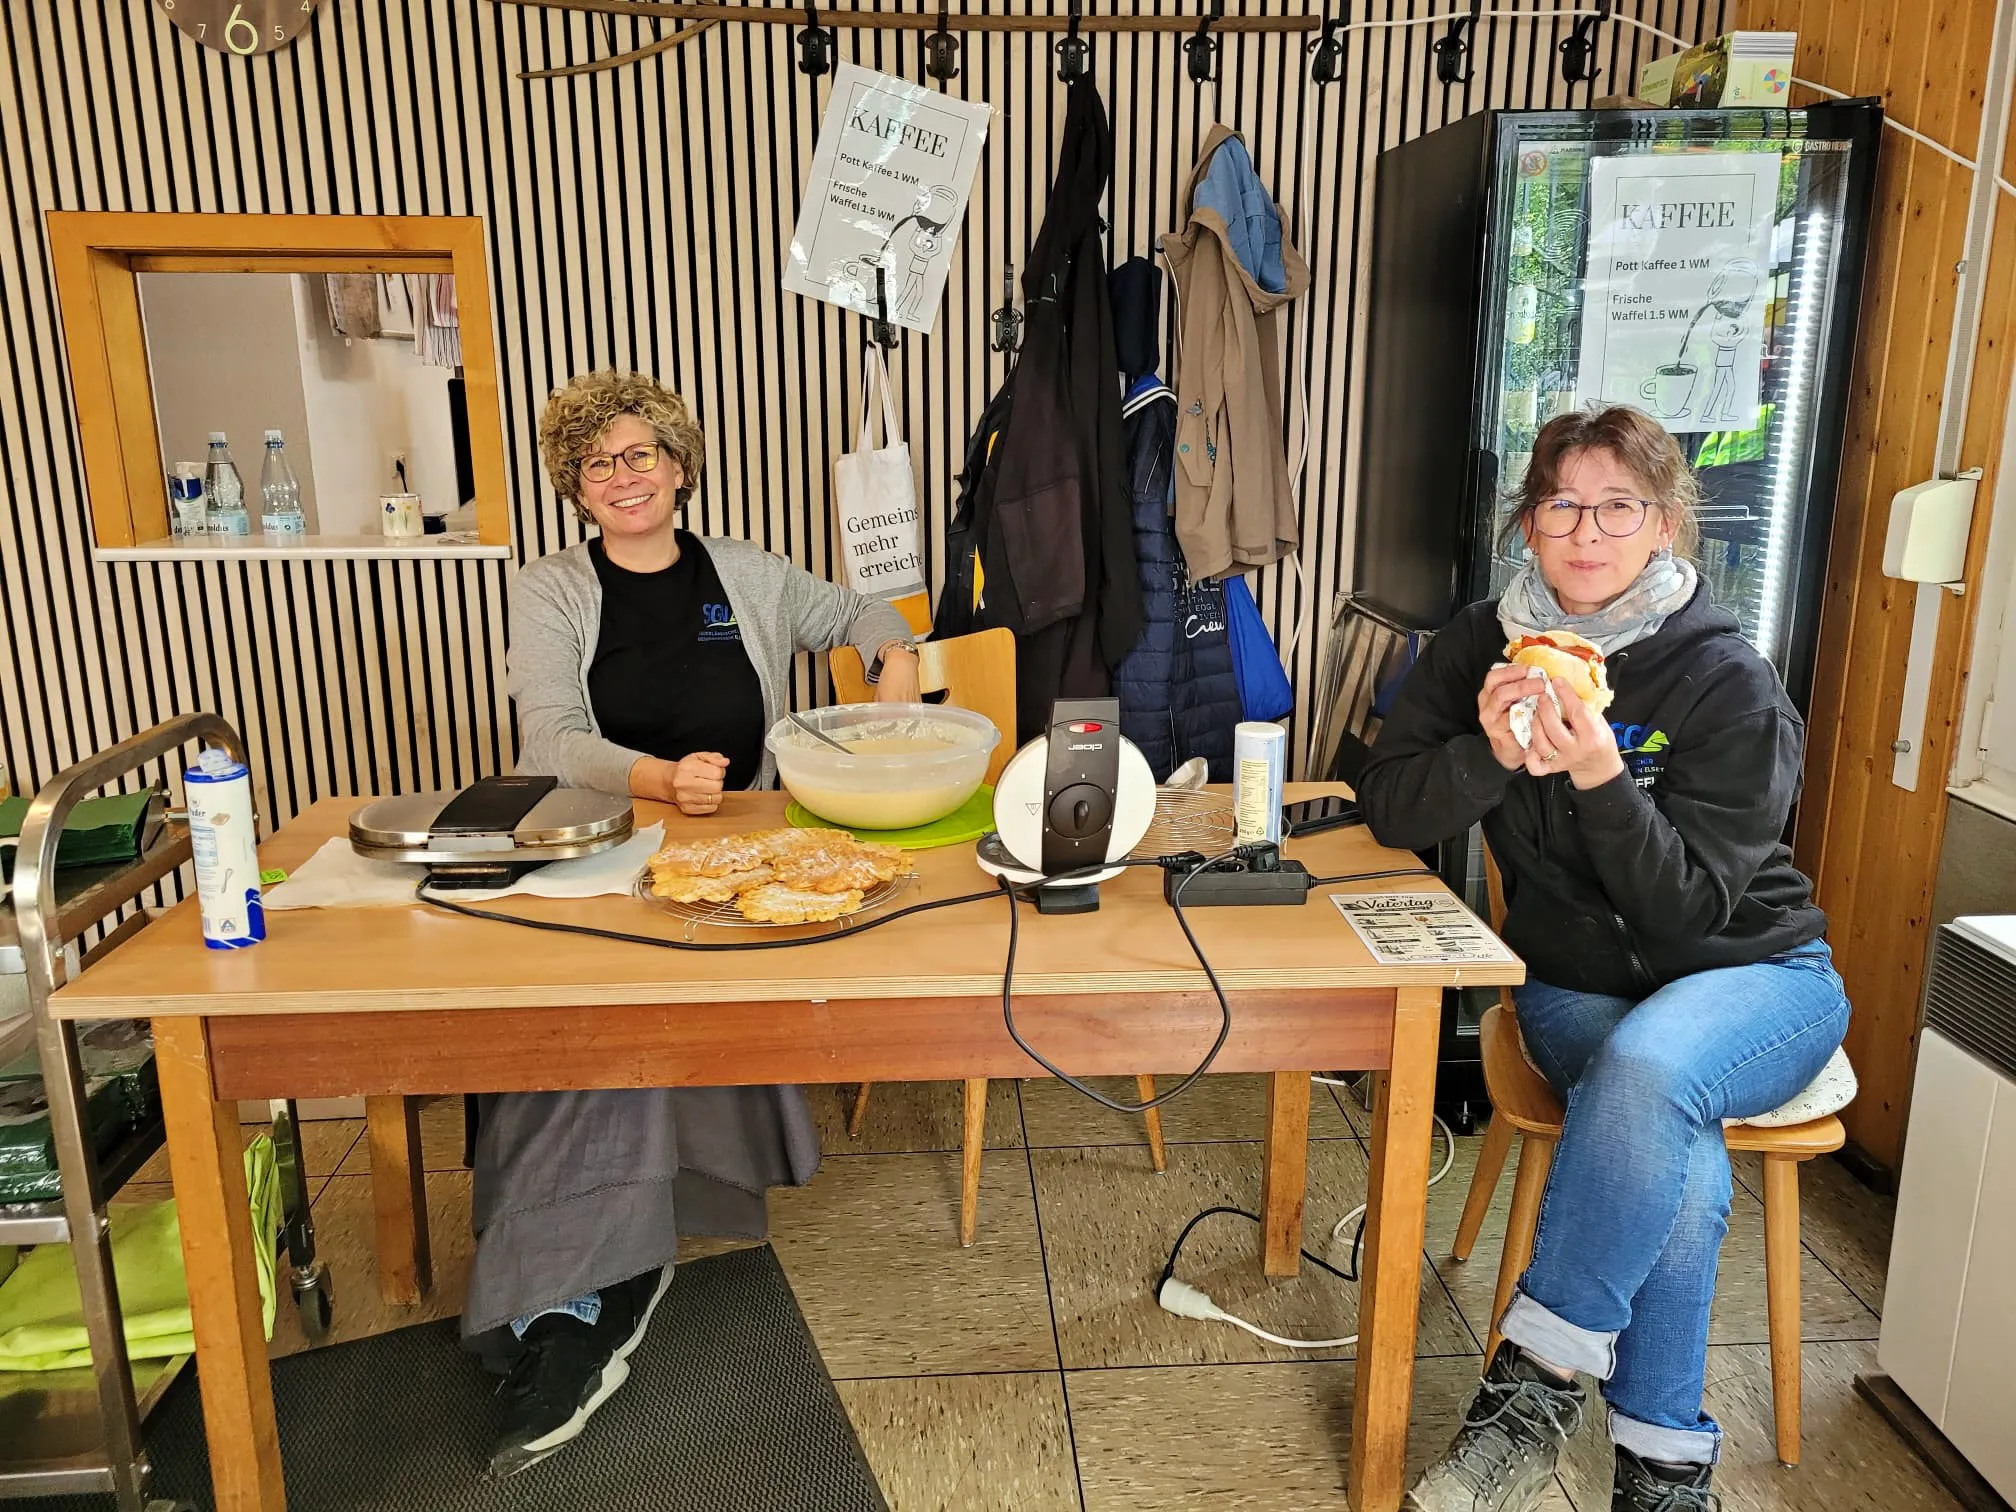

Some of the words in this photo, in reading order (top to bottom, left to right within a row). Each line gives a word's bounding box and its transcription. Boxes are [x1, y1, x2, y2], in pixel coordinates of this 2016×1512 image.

[300, 0, 311, 13] 4
[197, 23, 207, 39] 7
[224, 3, 259, 55] 6
[274, 25, 285, 41] 5
[849, 105, 949, 159] KAFFEE
[840, 153, 861, 168] Pott
[862, 159, 893, 178] Kaffee
[894, 170, 901, 180] 1
[901, 172, 920, 186] WM
[832, 180, 868, 199] Frische
[829, 193, 861, 211] Waffel
[861, 203, 877, 216] 1.5
[877, 208, 896, 223] WM
[1620, 201, 1735, 230] KAFFEE
[1615, 260, 1639, 272] Pott
[1641, 259, 1678, 271] Kaffee
[1679, 259, 1687, 270] 1
[1688, 257, 1711, 270] WM
[1612, 292, 1653, 305] Frische
[1611, 309, 1648, 322] Waffel
[1649, 309, 1666, 321] 1.5
[1667, 308, 1690, 320] WM
[853, 534, 899, 557] mehr
[1184, 614, 1225, 639] Crew
[1067, 743, 1103, 751] cloer
[1355, 898, 1434, 911] Vatertag
